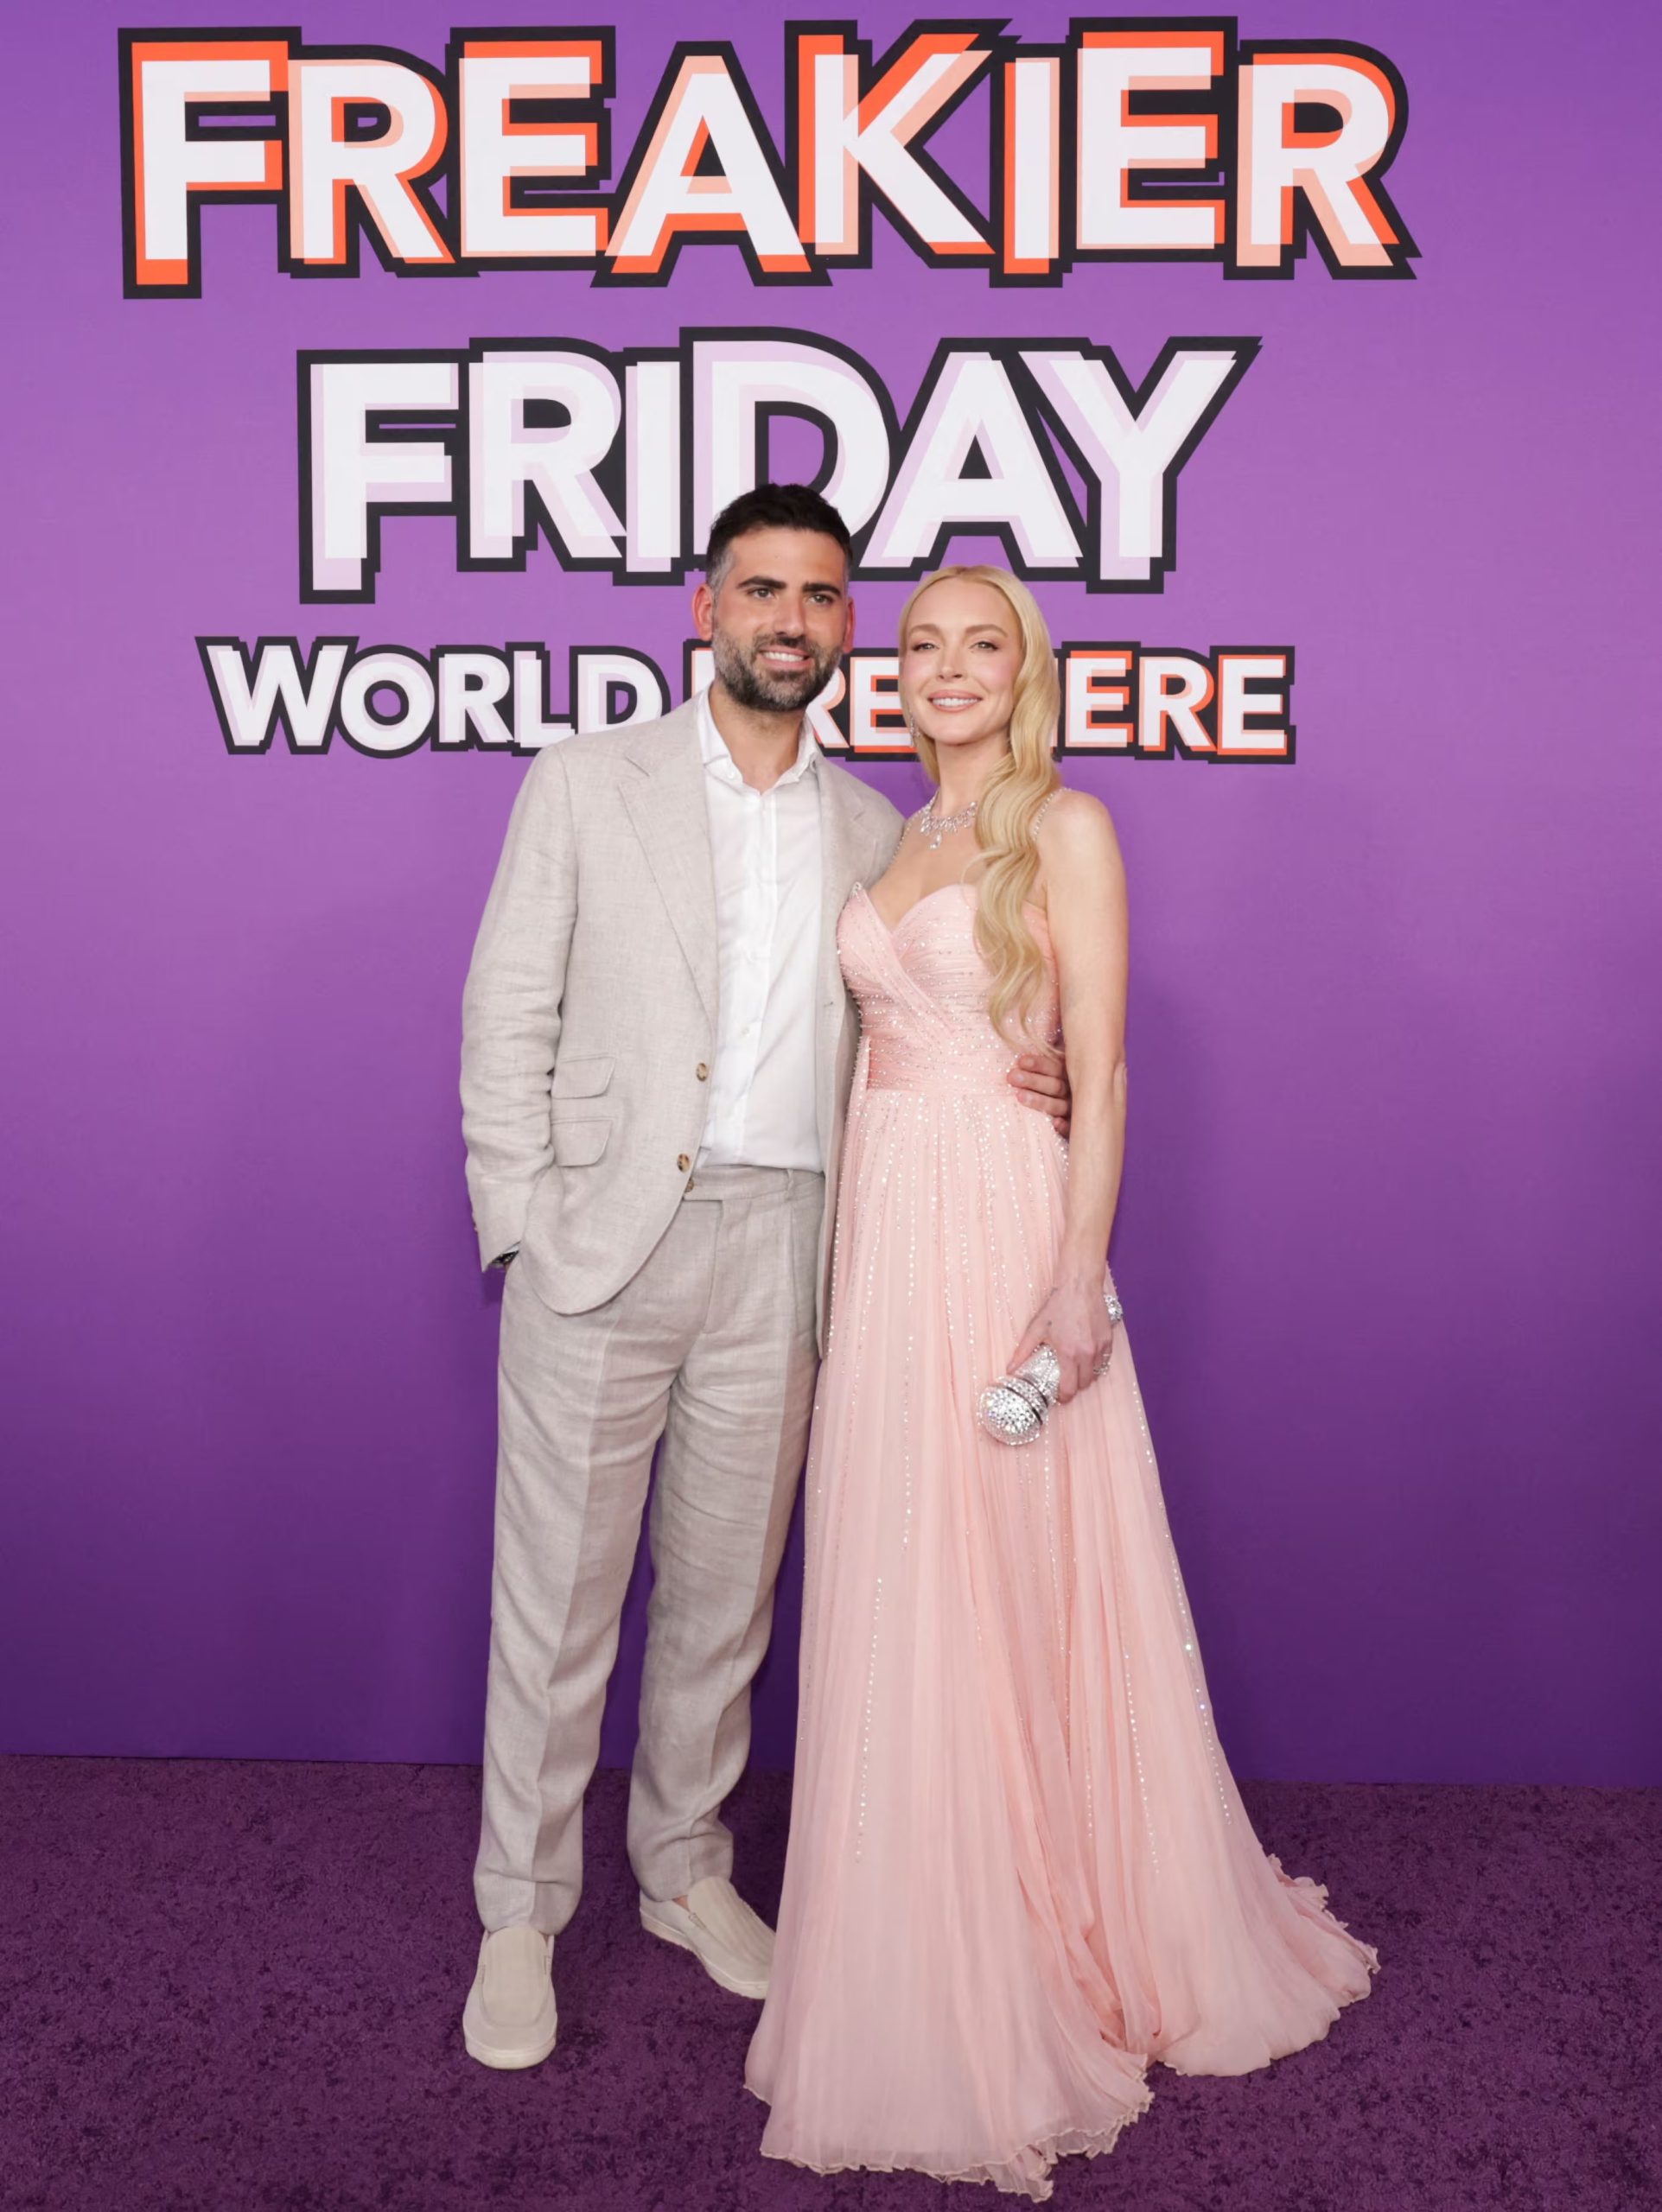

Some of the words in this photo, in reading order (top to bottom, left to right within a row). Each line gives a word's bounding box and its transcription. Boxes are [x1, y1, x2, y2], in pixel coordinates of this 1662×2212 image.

[119, 16, 1422, 299] FREAKIER
[296, 327, 1263, 604] FRIDAY
[194, 636, 671, 759] WORLD
